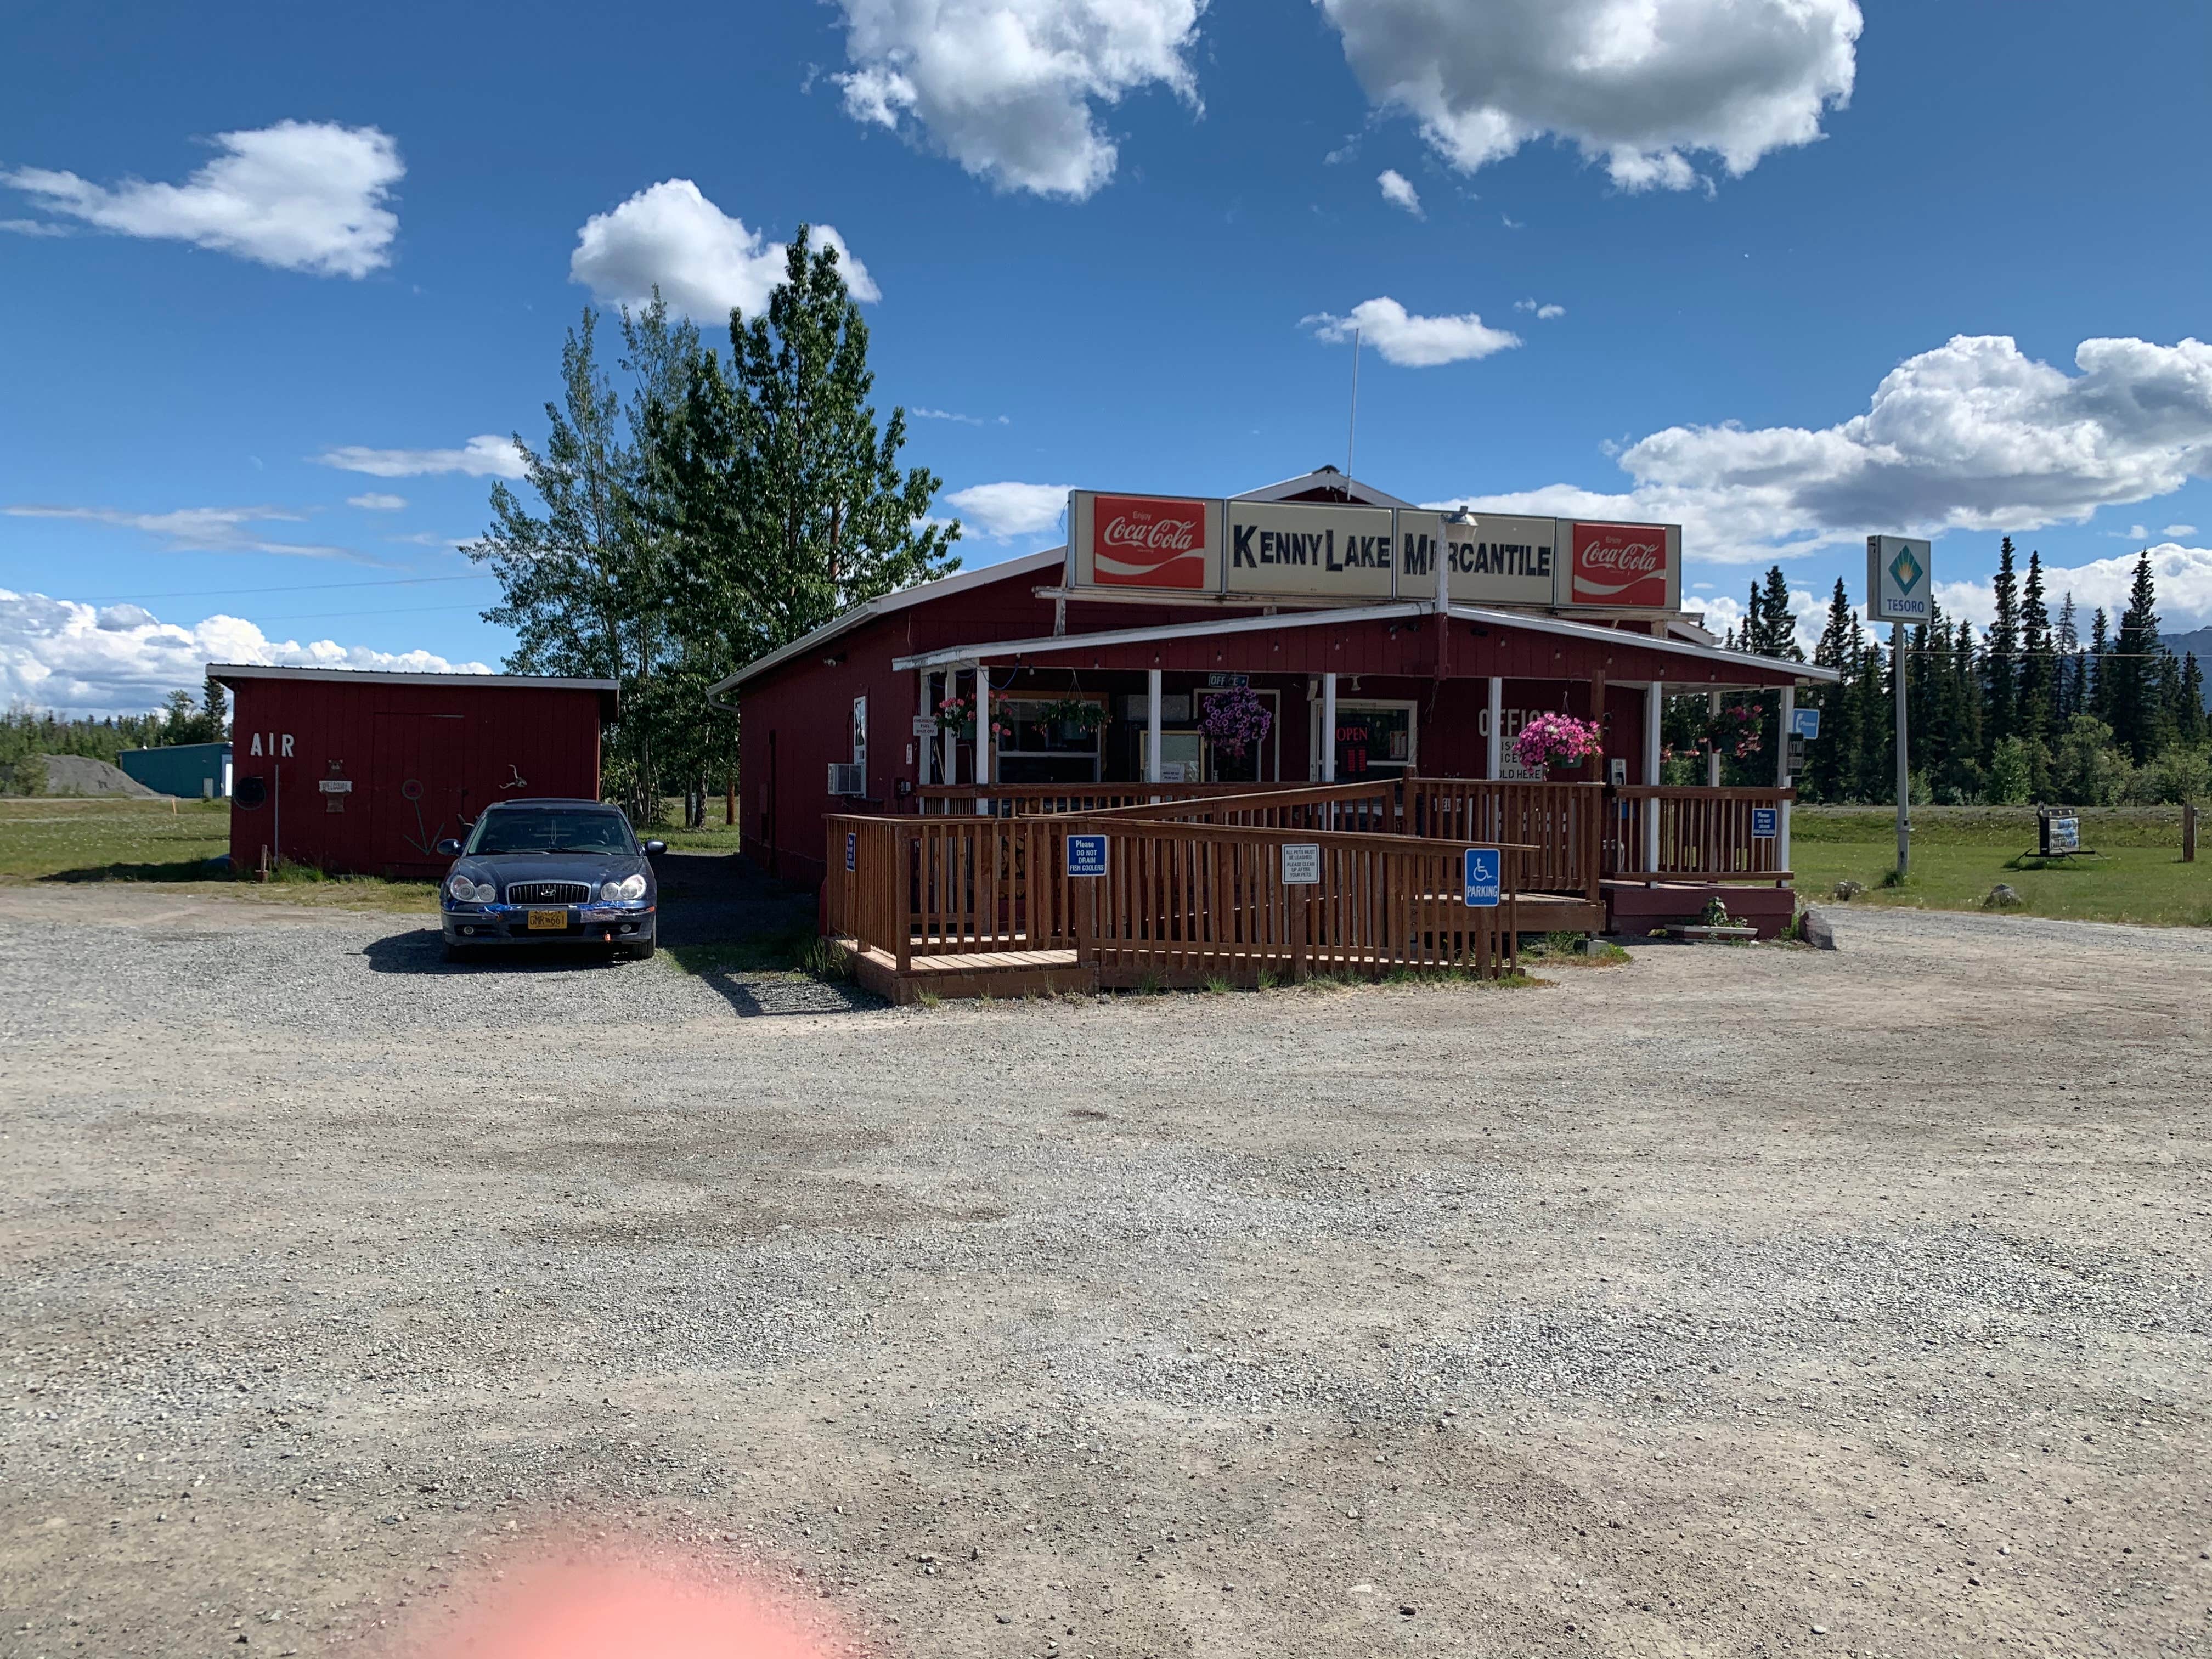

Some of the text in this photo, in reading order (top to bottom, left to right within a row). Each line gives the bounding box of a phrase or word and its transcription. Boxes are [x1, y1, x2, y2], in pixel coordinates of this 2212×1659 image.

[1133, 511, 1152, 521] Enjoy
[1103, 516, 1197, 550] Coca-Cola
[1582, 540, 1660, 571] Coca-Cola
[1887, 599, 1925, 613] TESORO
[1336, 727, 1368, 741] OPEN
[250, 732, 295, 758] AIR
[1517, 769, 1541, 779] HERE
[1467, 885, 1497, 898] PARKING
